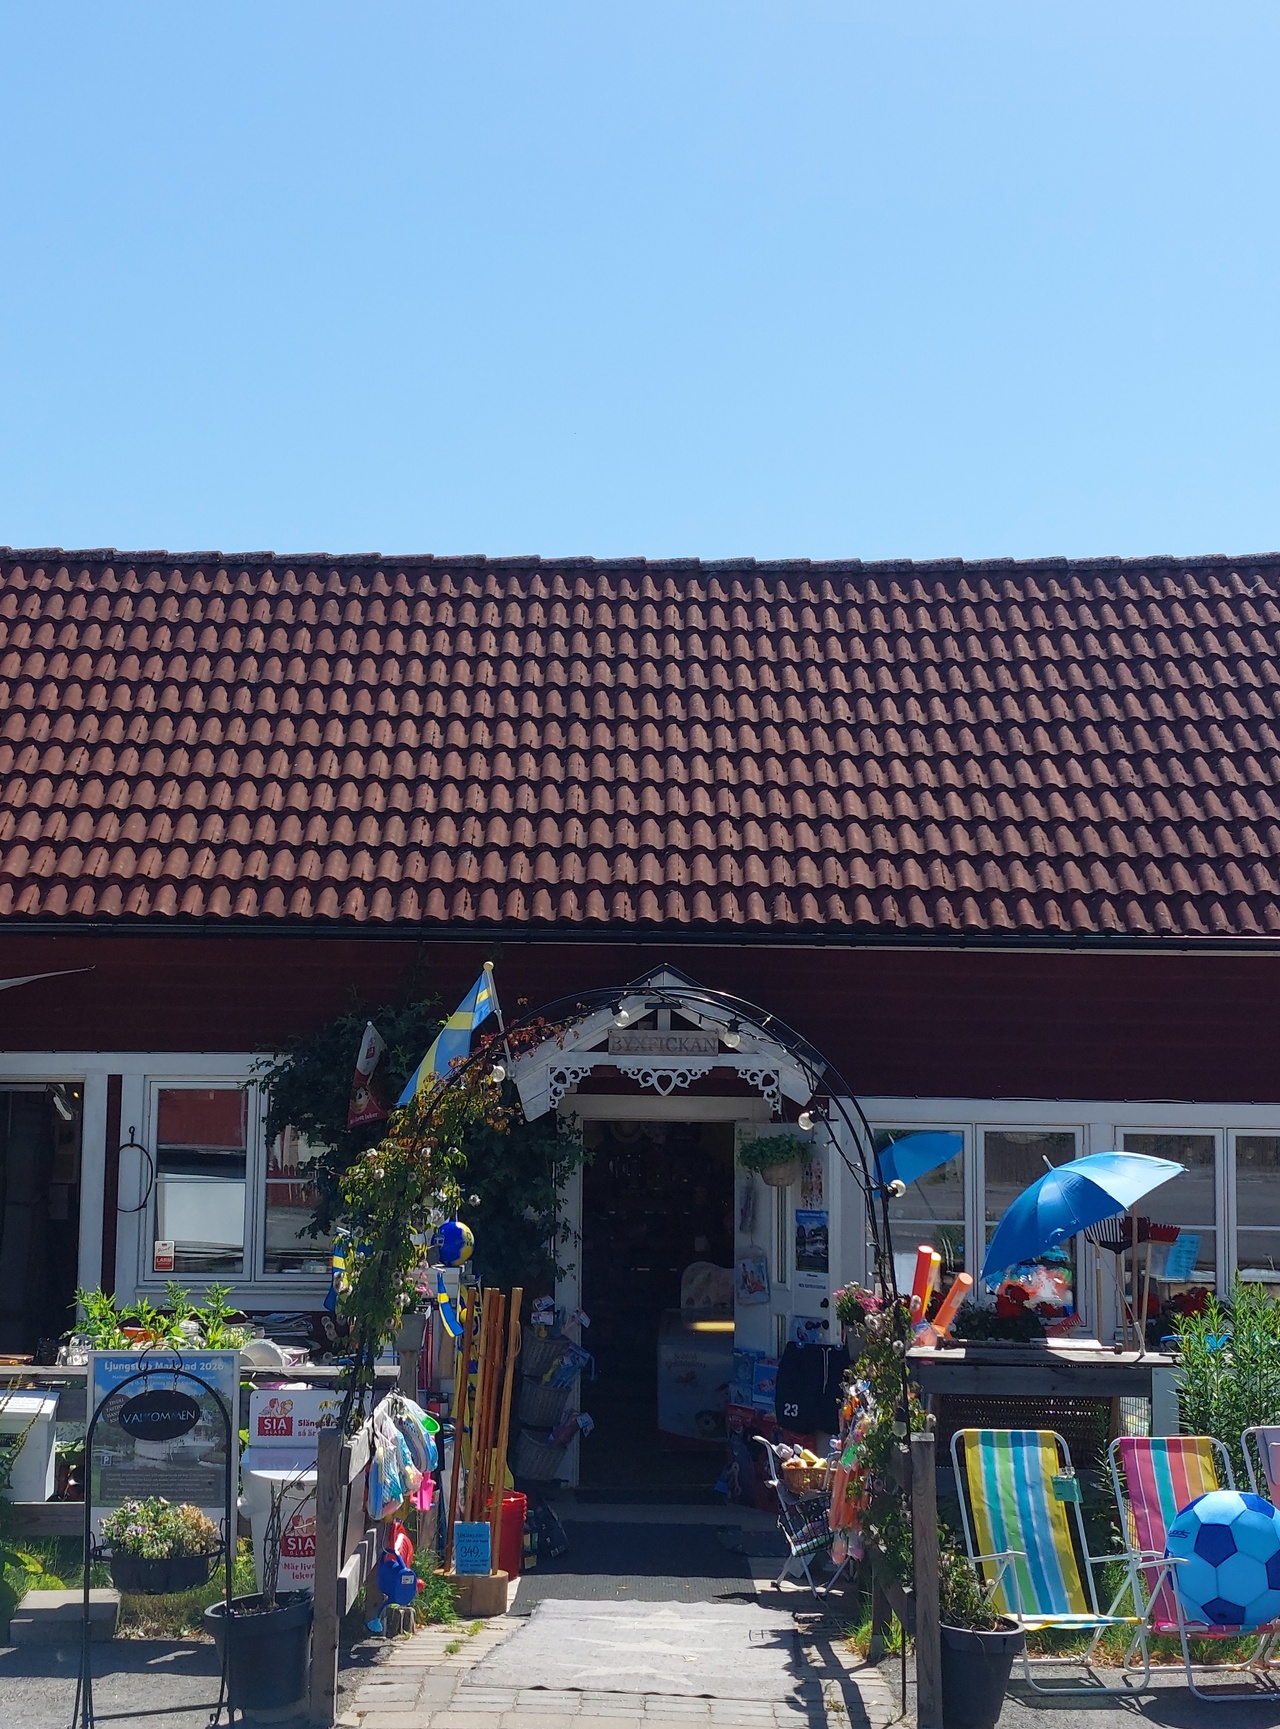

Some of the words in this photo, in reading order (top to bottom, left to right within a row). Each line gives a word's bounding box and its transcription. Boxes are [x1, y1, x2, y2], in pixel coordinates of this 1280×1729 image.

[784, 1403, 799, 1417] 23
[264, 1418, 287, 1430] SIA
[287, 1537, 316, 1550] SIA
[283, 1562, 300, 1571] När
